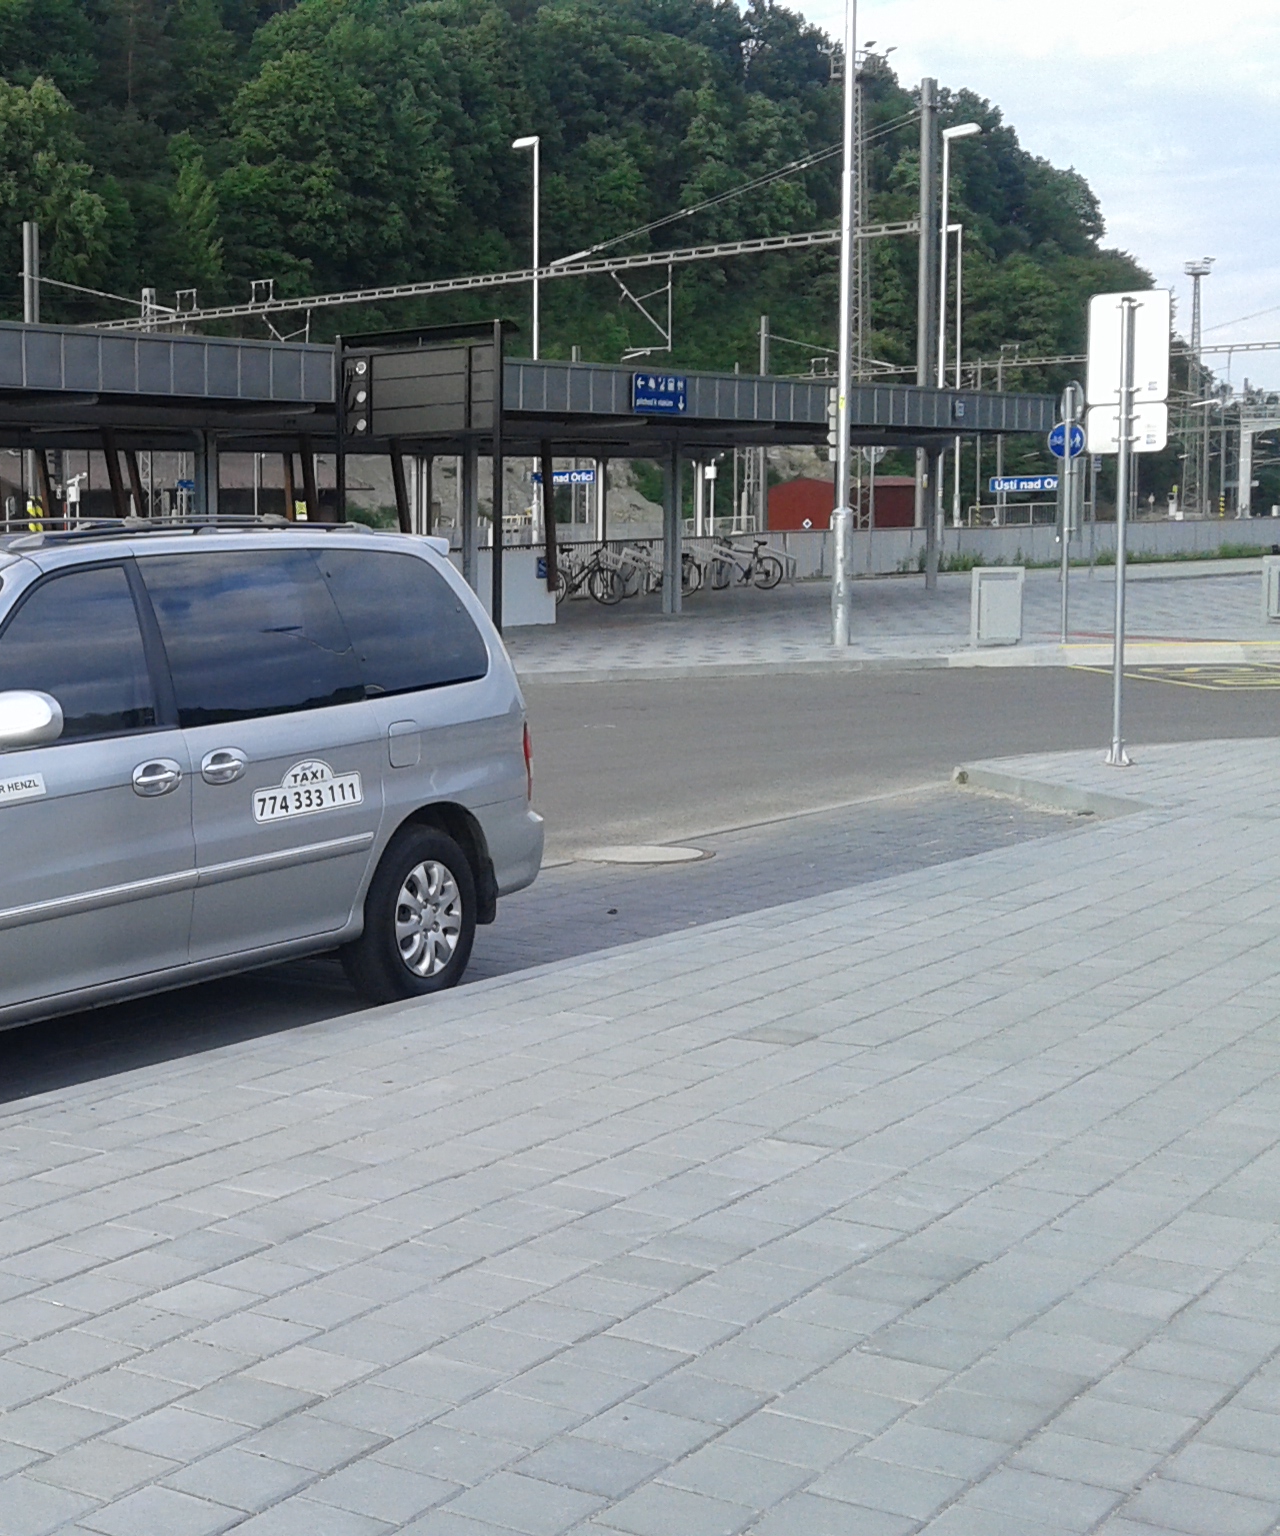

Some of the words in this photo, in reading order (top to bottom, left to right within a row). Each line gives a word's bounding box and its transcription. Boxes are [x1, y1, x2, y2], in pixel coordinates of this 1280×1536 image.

[994, 477, 1017, 490] Ústí
[1019, 479, 1041, 489] nad
[291, 769, 325, 784] TAXI
[7, 779, 39, 793] HENZL
[257, 795, 289, 816] 774
[293, 789, 324, 810] 333
[328, 783, 356, 802] 111
